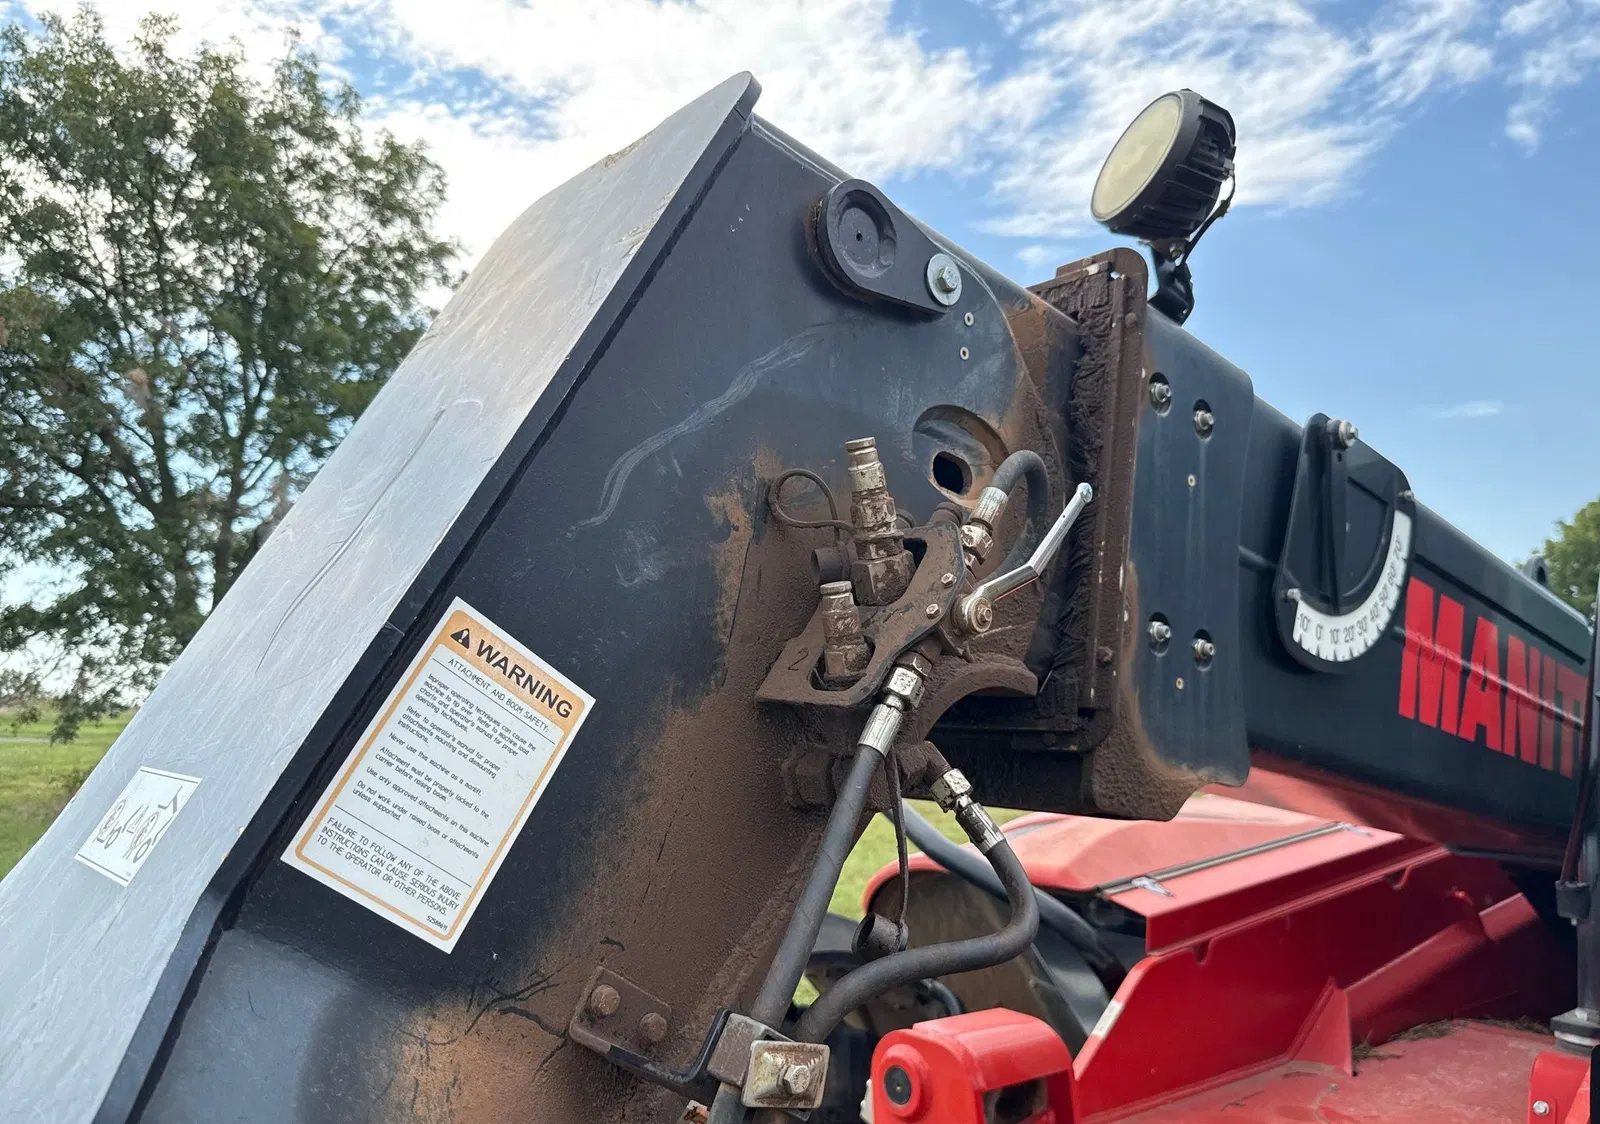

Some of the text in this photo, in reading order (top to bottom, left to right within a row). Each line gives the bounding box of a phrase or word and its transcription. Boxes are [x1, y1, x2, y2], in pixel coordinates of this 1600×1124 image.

[415, 694, 467, 732] operating techniques.
[428, 673, 536, 751] Improper operating techniques can cause the
[448, 658, 548, 732] ATTACHMENT AND BOOM SAFETY:
[476, 639, 572, 718] WARNING
[1398, 576, 1588, 779] MANIT
[397, 719, 428, 743] instructions.
[402, 713, 496, 779] attachments mounting and dismounting
[406, 705, 500, 771] Refer to operator's manual for proper
[419, 687, 437, 701] charts
[438, 700, 449, 709] and
[449, 707, 475, 727] operator's
[475, 725, 493, 739] manual
[501, 743, 518, 756] proper
[424, 681, 444, 697] machine
[445, 694, 451, 702] to
[460, 706, 473, 717] over.
[476, 716, 491, 728] Refer
[498, 732, 517, 747] machine
[518, 745, 529, 755] load
[375, 754, 446, 801] carrier before raising boom.
[379, 746, 410, 768] Attachment
[410, 766, 424, 776] must
[424, 774, 432, 782] be
[432, 780, 454, 797] properly
[455, 794, 473, 808] locked
[480, 810, 489, 819] the
[388, 732, 405, 745] Never
[406, 744, 417, 753] use
[418, 751, 428, 761] this
[429, 759, 450, 775] machine
[464, 782, 481, 796] manlift.
[352, 788, 401, 821] unless supported.
[357, 780, 365, 789] Do
[366, 787, 377, 795] not
[378, 794, 391, 804] work
[392, 803, 408, 814] under
[408, 813, 427, 826] raised
[426, 823, 440, 835] boom
[448, 838, 479, 859] attachments
[366, 766, 378, 777] Use
[378, 775, 391, 785] only
[392, 783, 418, 802] approved
[418, 800, 449, 822] attachments
[458, 824, 468, 833] this
[469, 831, 489, 847] machine.
[317, 834, 447, 916] TO THE OPERATOR OR OTHER PERSONS.
[321, 826, 459, 910] INSTRUCTIONS CAN CAUSE SERIOUS INJURY
[327, 817, 461, 900] FAILURE TO FOLLOW ANY OF THE ABOVE
